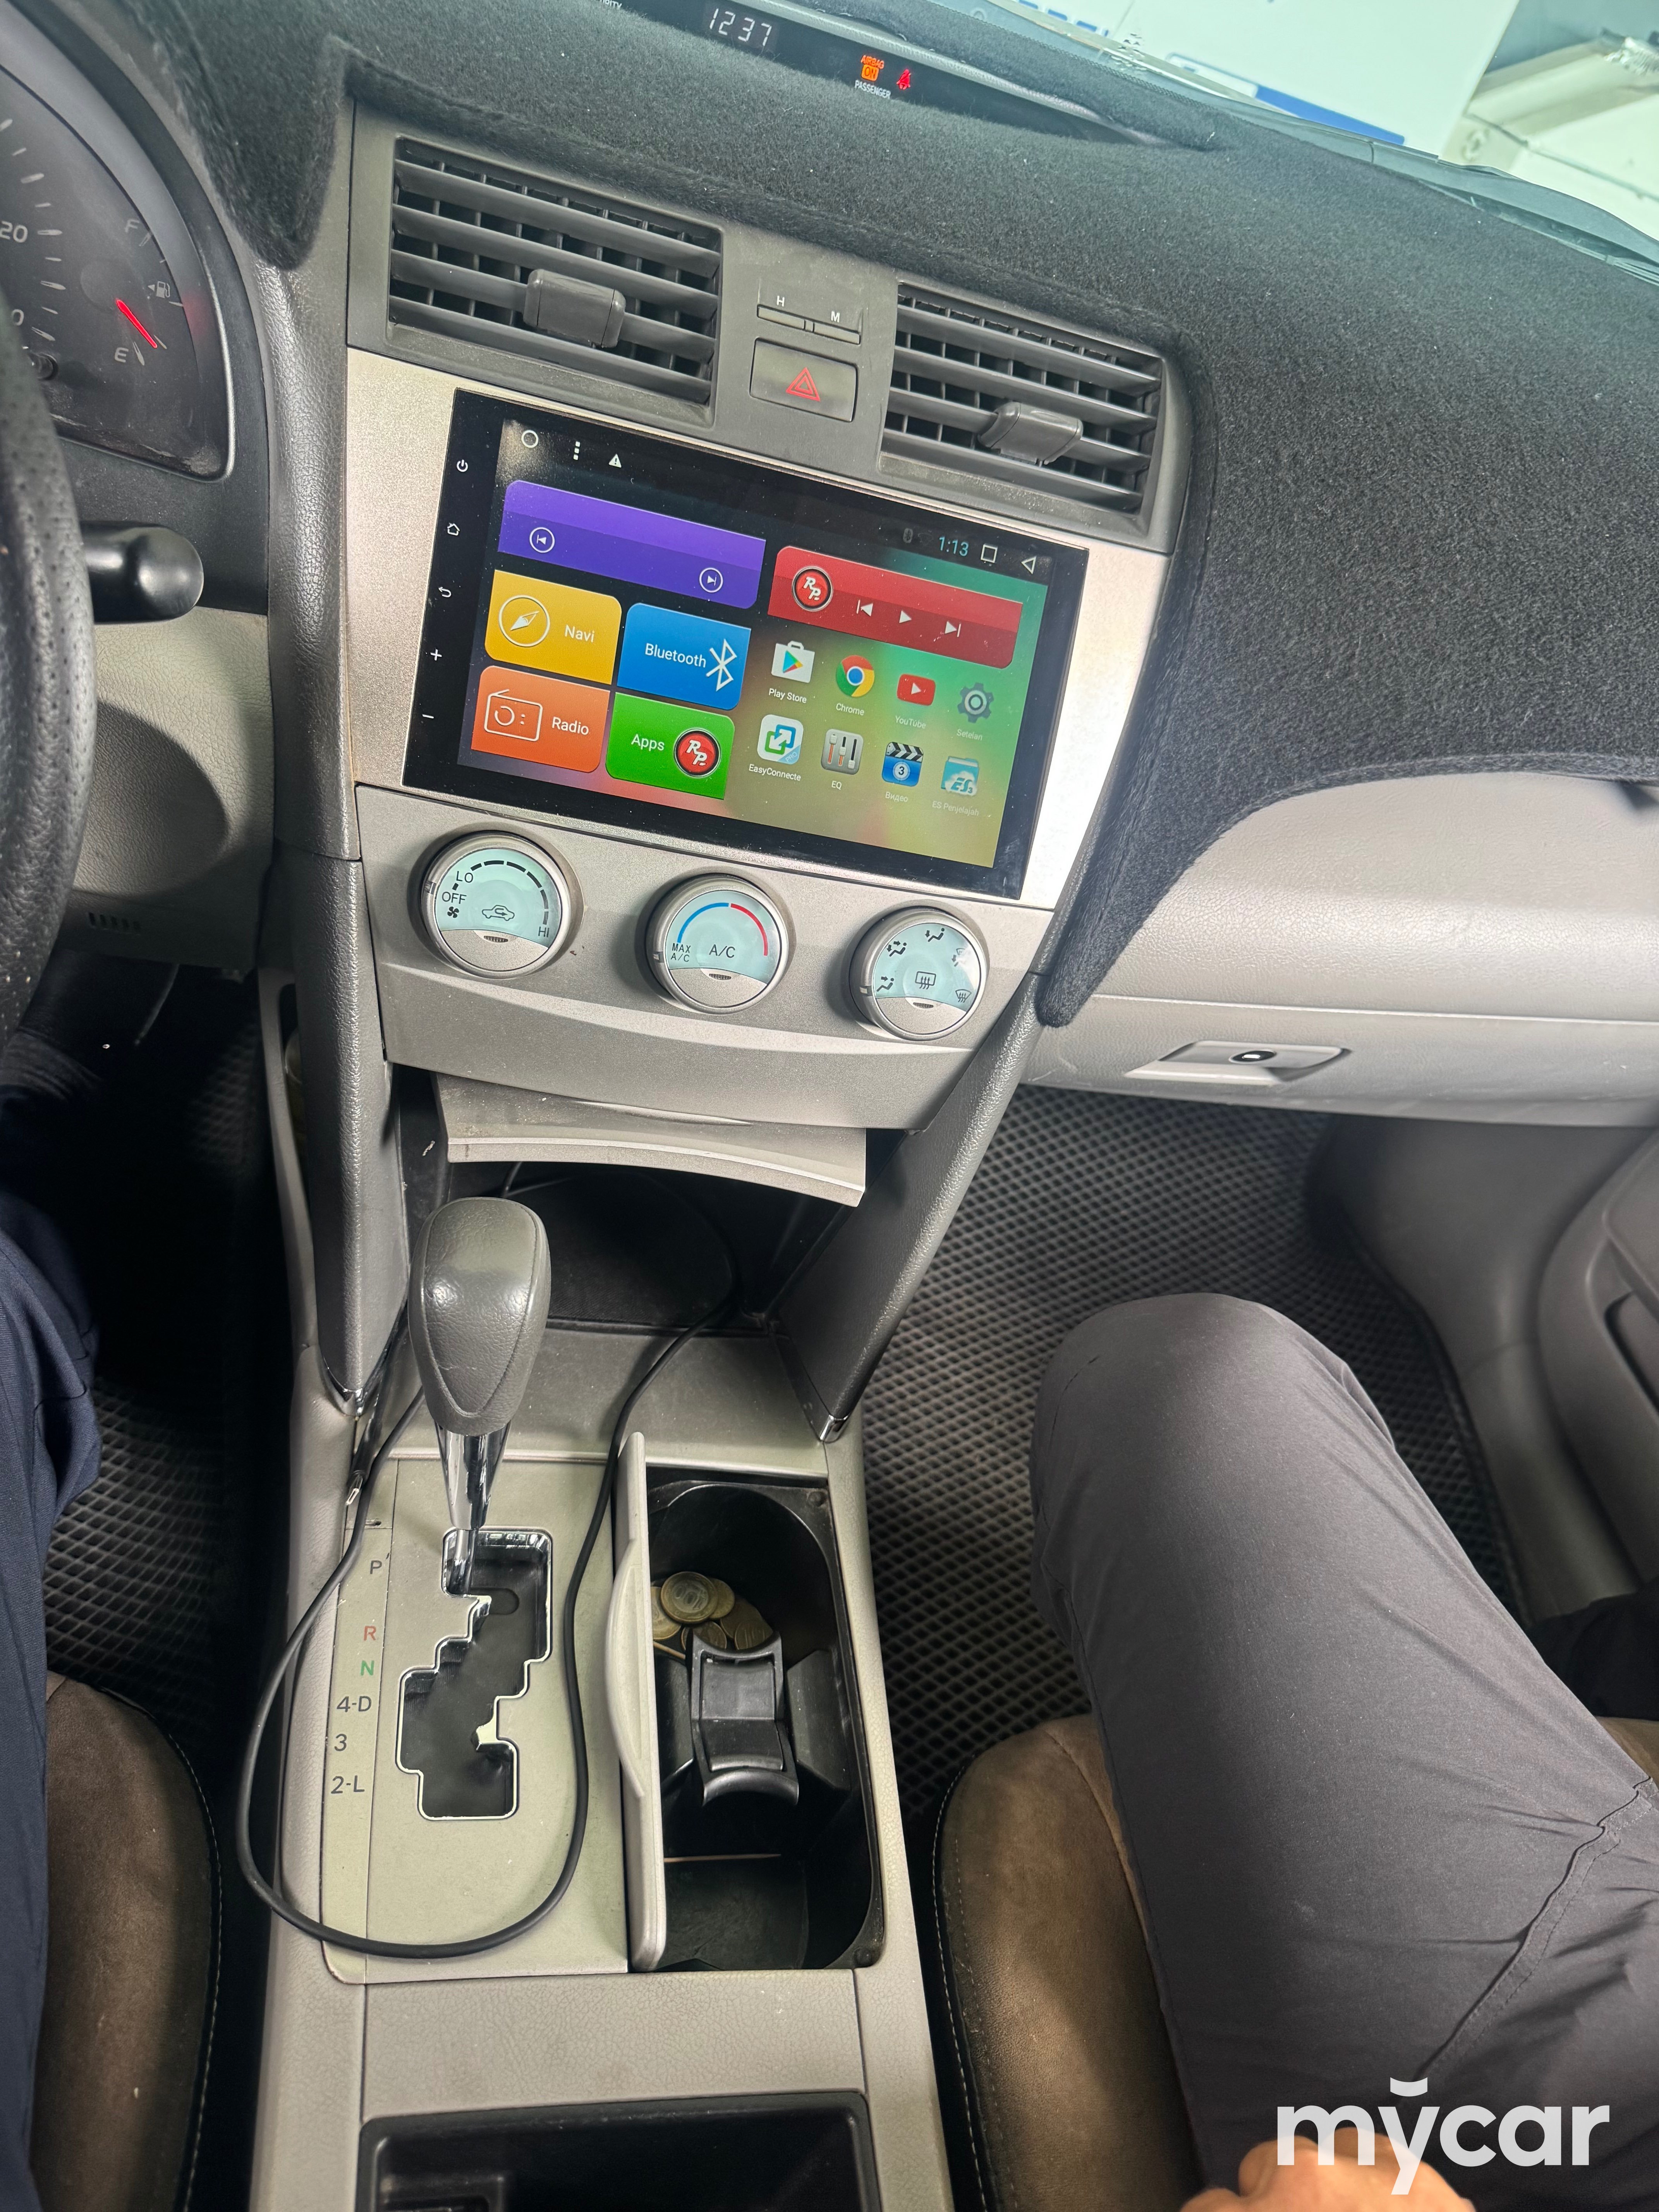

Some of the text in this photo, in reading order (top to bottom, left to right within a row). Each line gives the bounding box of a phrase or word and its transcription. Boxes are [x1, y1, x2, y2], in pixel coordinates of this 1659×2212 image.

[861, 55, 884, 69] AIRBAG
[865, 67, 876, 79] ON
[854, 79, 891, 99] PASSENGER
[125, 218, 139, 232] F
[776, 295, 785, 307] H
[831, 311, 840, 323] M
[115, 347, 129, 362] E
[939, 536, 968, 556] 1:13
[564, 625, 595, 642] Navi
[645, 643, 706, 668] Bluetooth
[769, 688, 807, 703] Play Store
[836, 703, 864, 716] Chrome
[552, 716, 589, 735] Radio
[895, 716, 926, 729] YouTube
[957, 729, 983, 741] Setelan
[631, 734, 665, 751] Apps
[785, 751, 797, 763] PRO
[749, 764, 801, 781] EasyConnecte
[898, 766, 905, 775] 3
[831, 780, 842, 790] EQ
[885, 791, 908, 802] Видео
[932, 800, 979, 816] ES Penjelajah
[456, 871, 473, 883] LO
[442, 891, 467, 904] OFF
[538, 926, 550, 938] HI
[672, 943, 691, 954] MAX
[709, 944, 736, 958] A/C
[671, 952, 690, 963] A/C
[369, 1560, 382, 1575] P
[363, 1626, 376, 1641] R
[360, 1660, 374, 1676] N
[337, 1695, 372, 1713] 4-D
[334, 1733, 347, 1752] 3
[331, 1775, 365, 1794] 2-L
